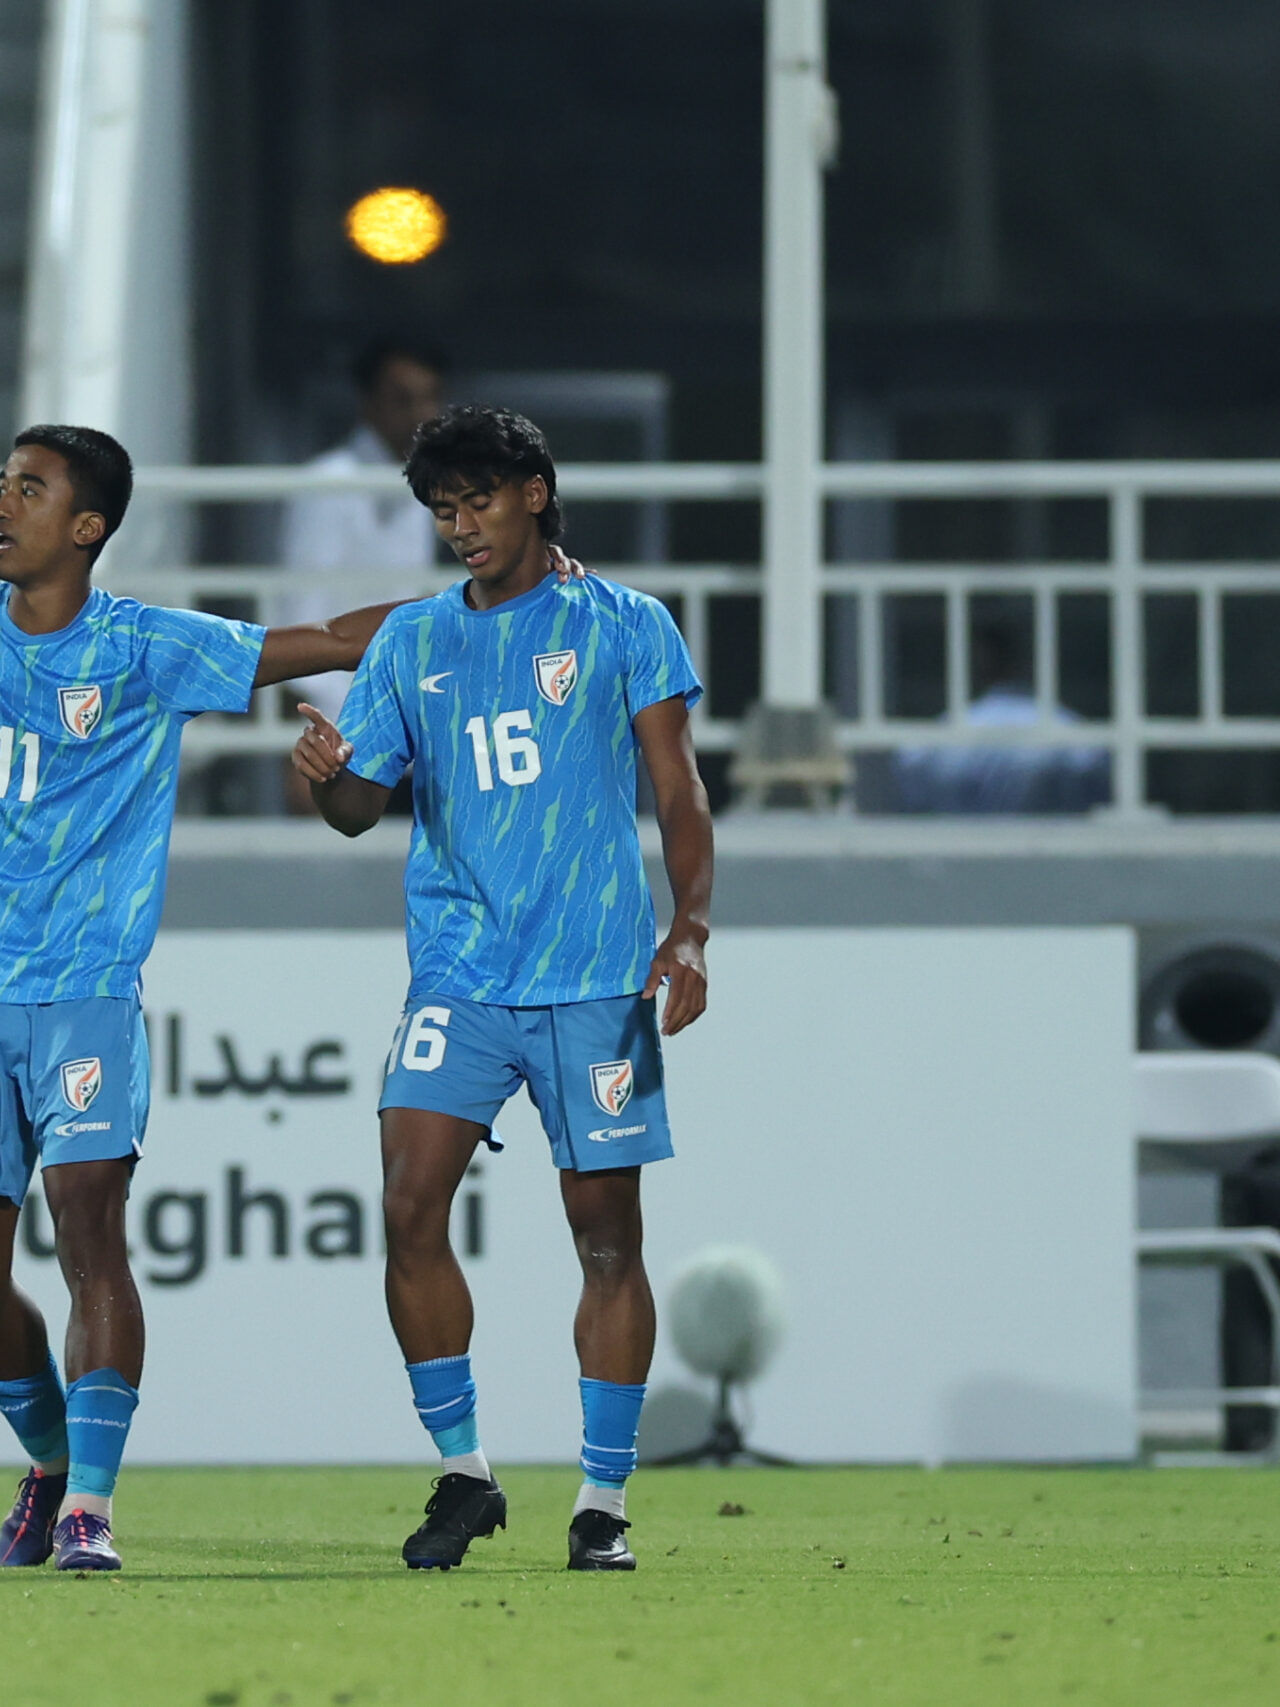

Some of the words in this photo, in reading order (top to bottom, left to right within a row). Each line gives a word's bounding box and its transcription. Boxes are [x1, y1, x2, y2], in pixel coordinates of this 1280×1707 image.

[541, 658, 563, 668] INDIA
[65, 693, 88, 701] INDIA
[464, 709, 542, 791] 16
[67, 1066, 88, 1075] INDIA
[597, 1068, 619, 1077] INDIA
